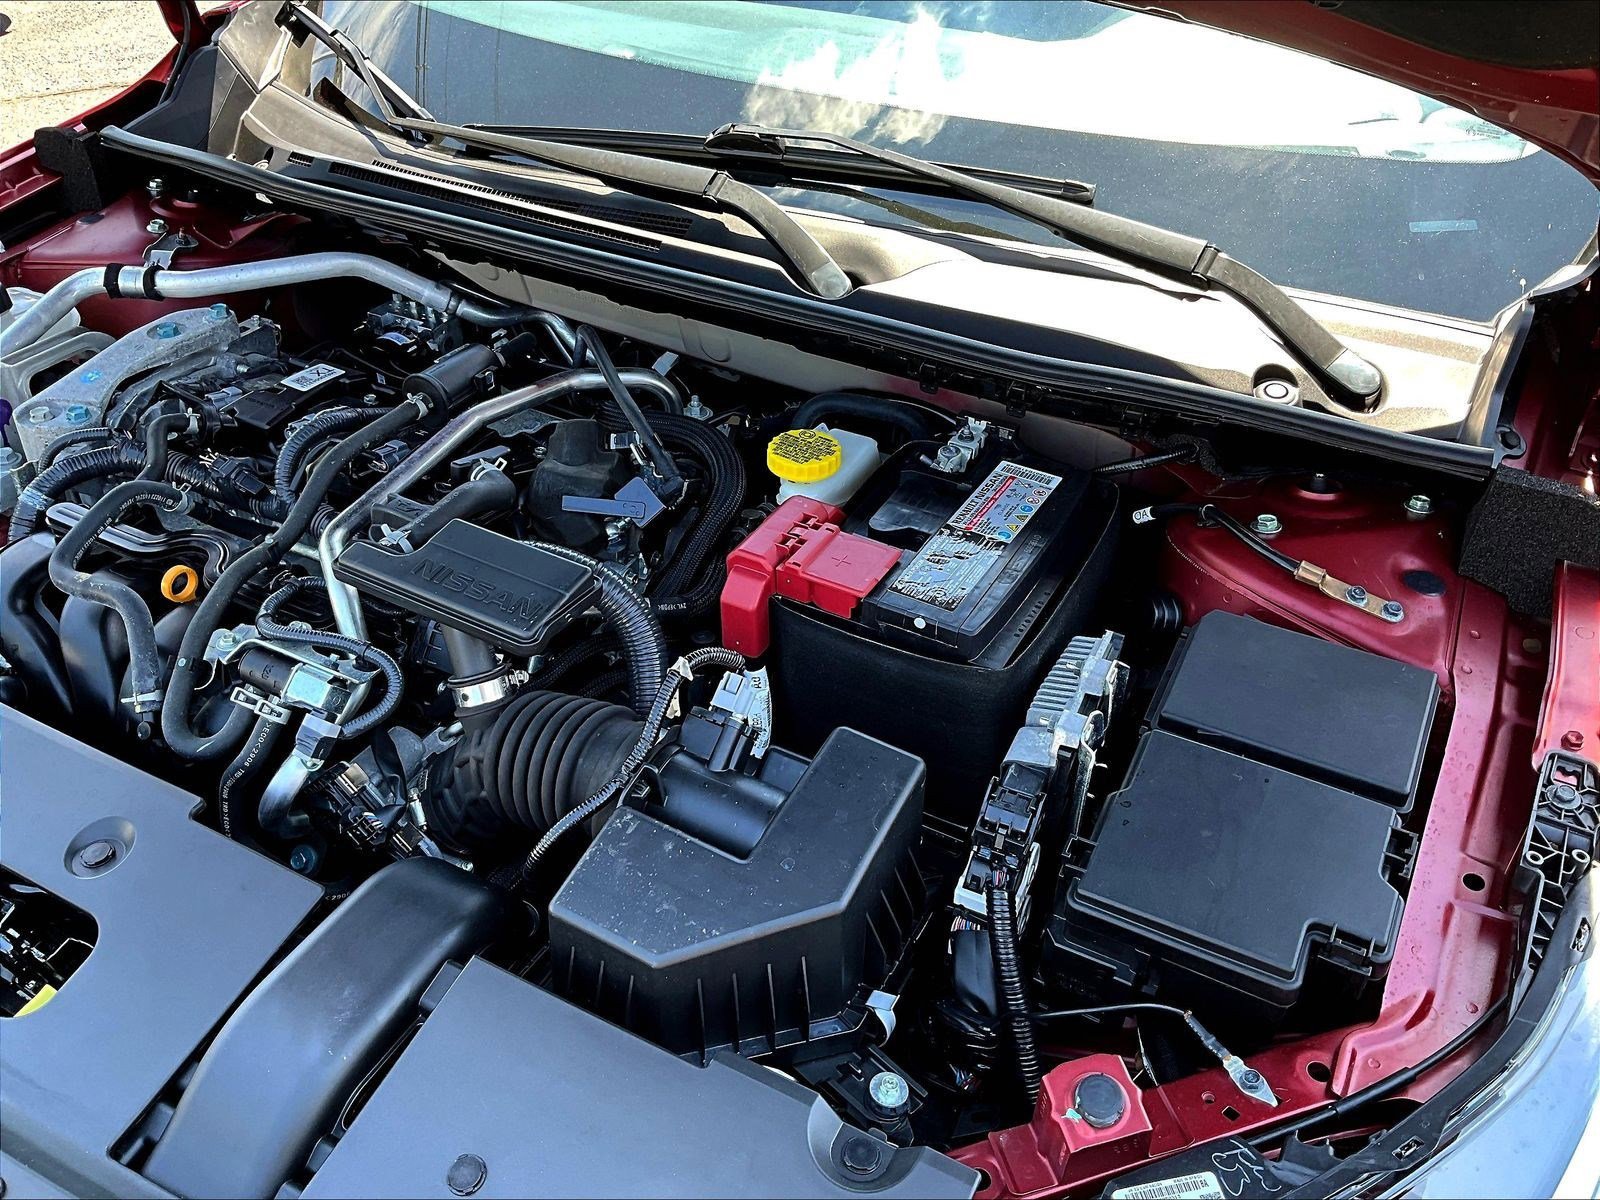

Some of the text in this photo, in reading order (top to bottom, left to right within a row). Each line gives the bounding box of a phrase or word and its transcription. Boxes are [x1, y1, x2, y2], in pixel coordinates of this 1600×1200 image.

[952, 498, 978, 524] RENAULT
[975, 472, 1003, 500] NISSAN
[410, 558, 543, 620] NISSAN
